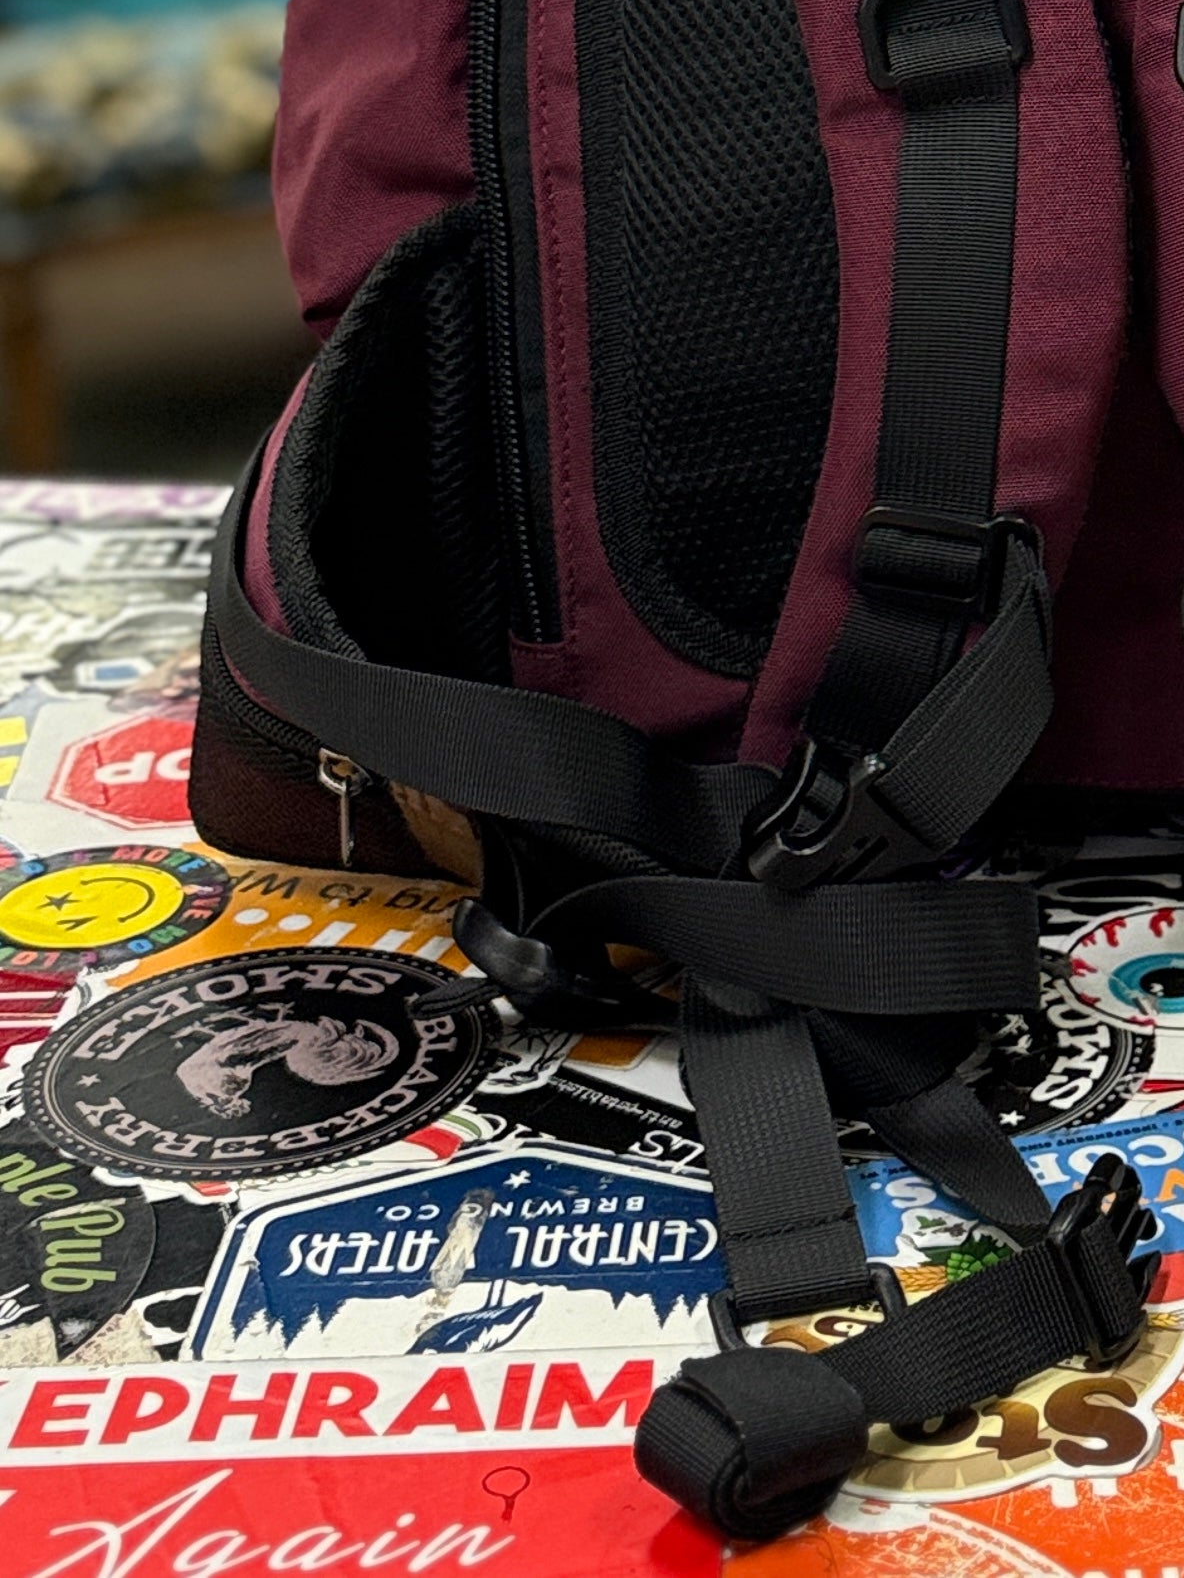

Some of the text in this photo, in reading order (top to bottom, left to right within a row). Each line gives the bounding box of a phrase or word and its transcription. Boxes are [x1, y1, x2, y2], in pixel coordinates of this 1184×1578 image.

[79, 963, 402, 1060] SMOKE
[75, 1010, 456, 1161] BLACKBERRY
[40, 1196, 126, 1293] Pub
[376, 1203, 441, 1221] CO.
[507, 1218, 719, 1266] CENTRAL
[8, 1359, 654, 1448] EPHRAIM
[33, 1468, 515, 1578] Again
